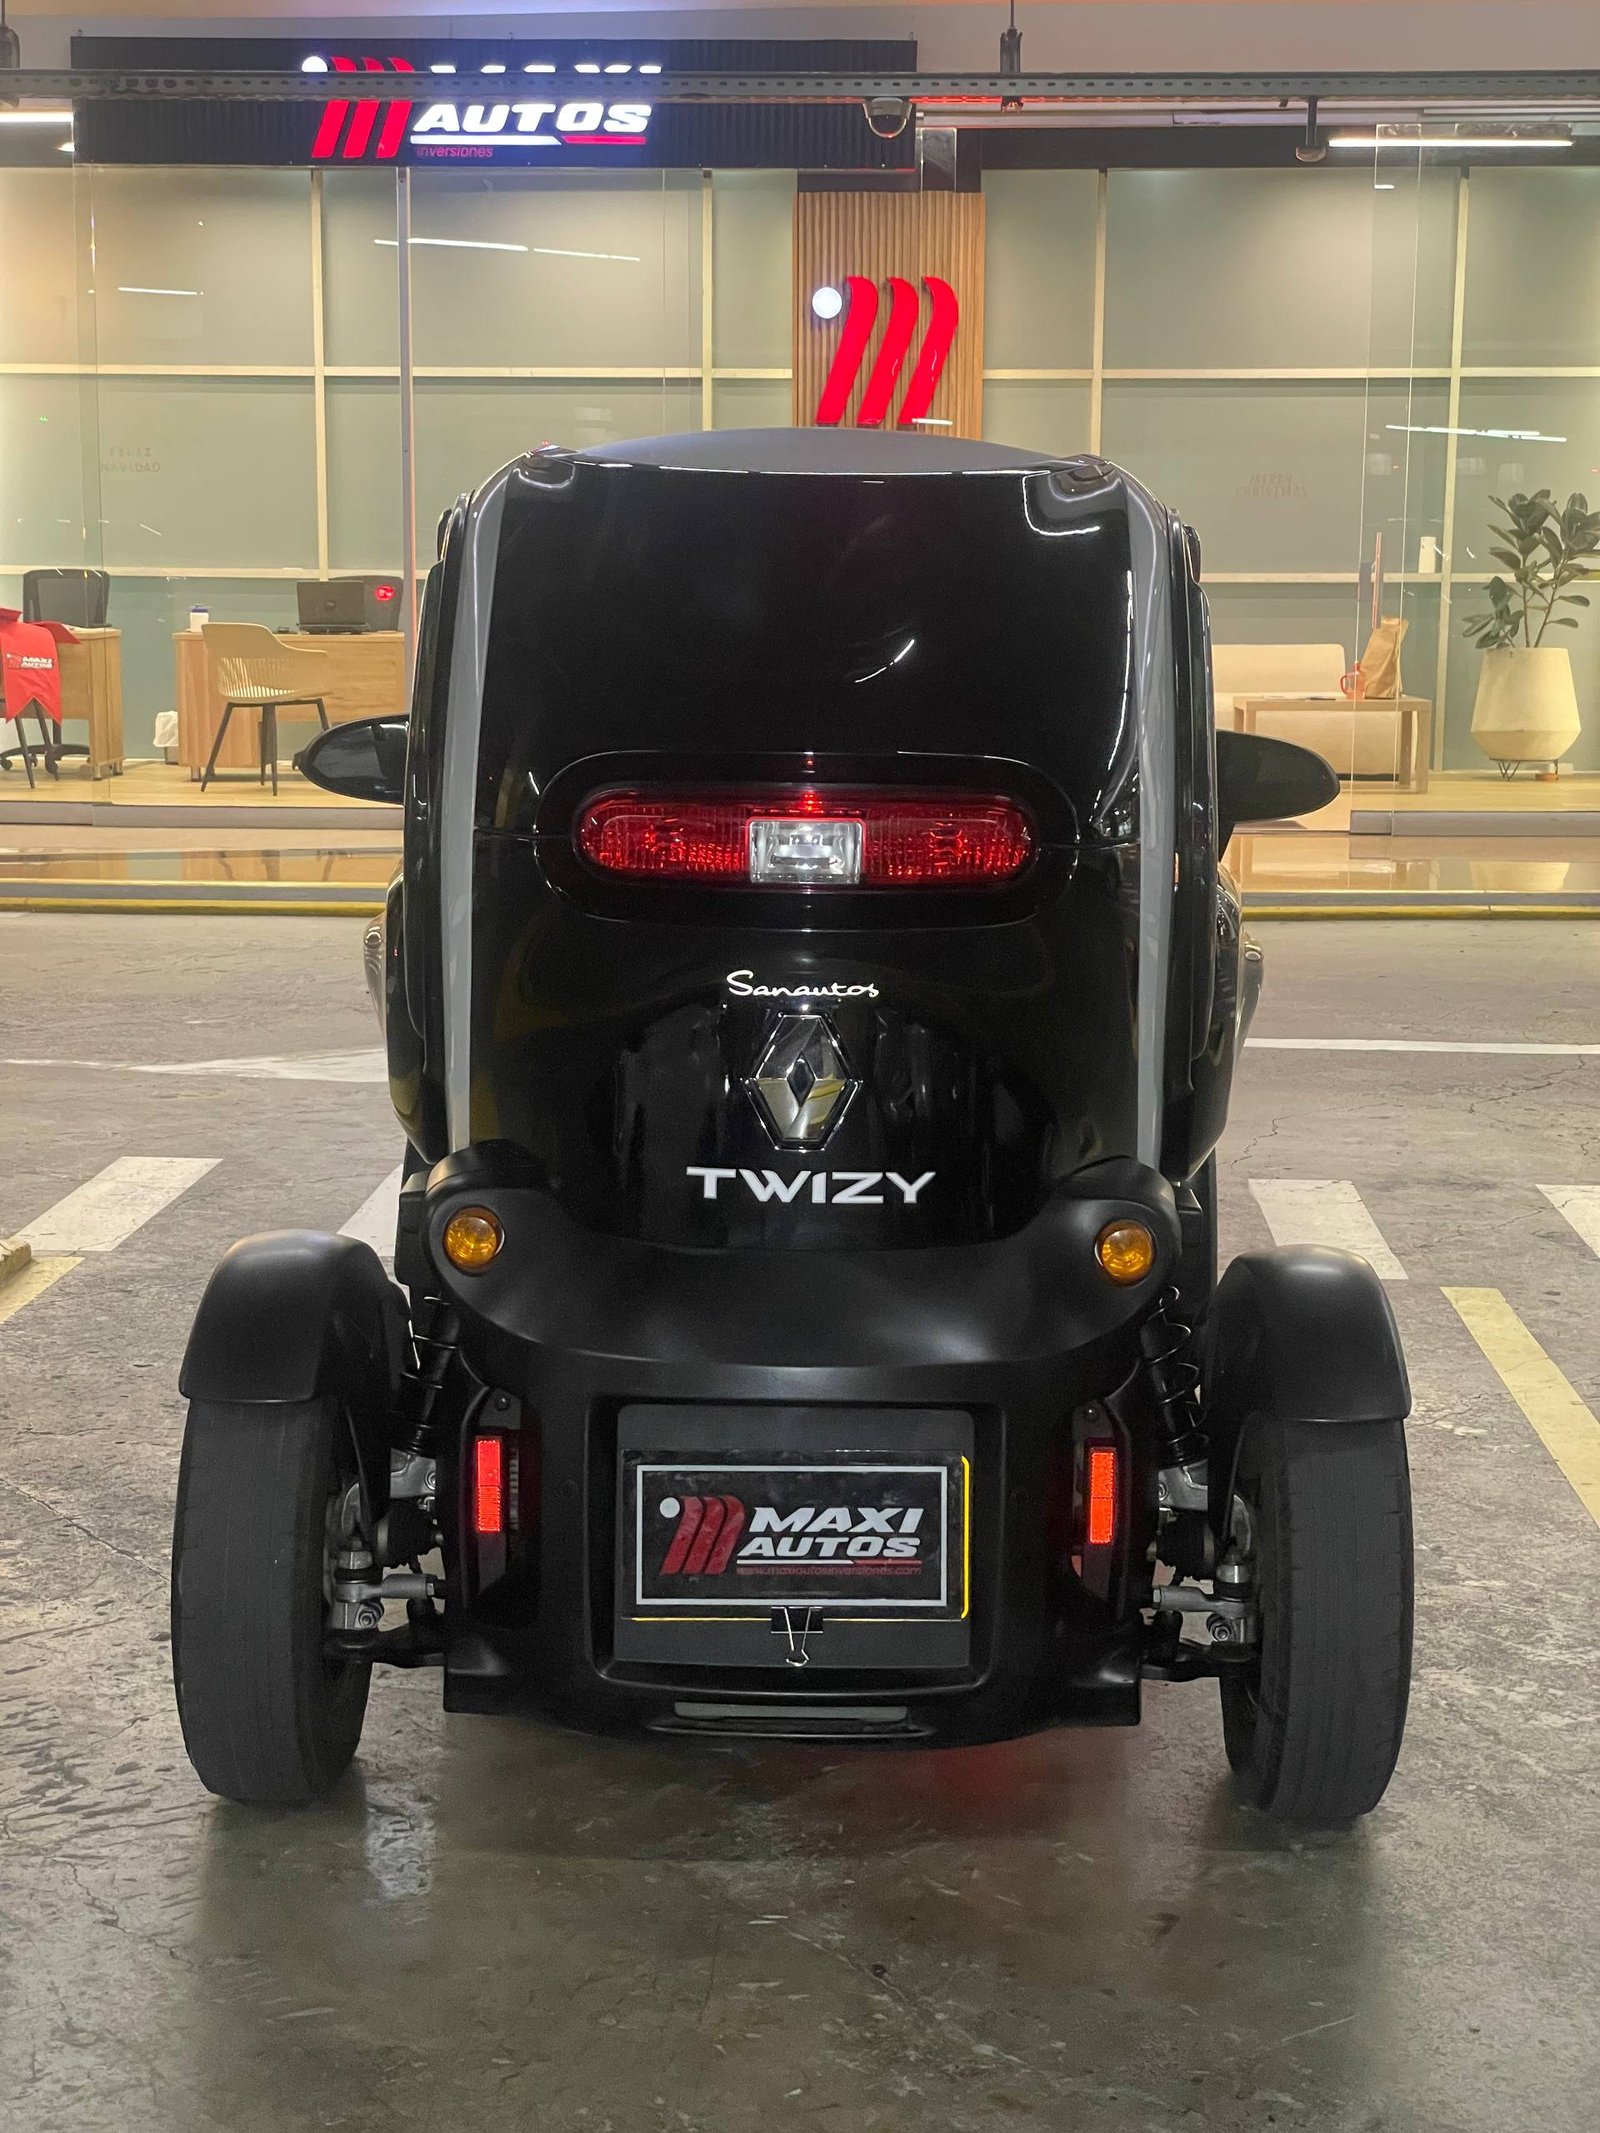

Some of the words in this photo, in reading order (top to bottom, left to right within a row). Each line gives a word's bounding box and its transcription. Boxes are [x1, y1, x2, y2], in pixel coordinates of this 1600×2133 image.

[412, 103, 653, 133] AUTOS
[416, 145, 494, 159] inversiones
[726, 970, 879, 998] Sanautos
[686, 1166, 937, 1204] TWIZY
[749, 1506, 925, 1533] MAXI
[736, 1536, 921, 1558] AUTOS
